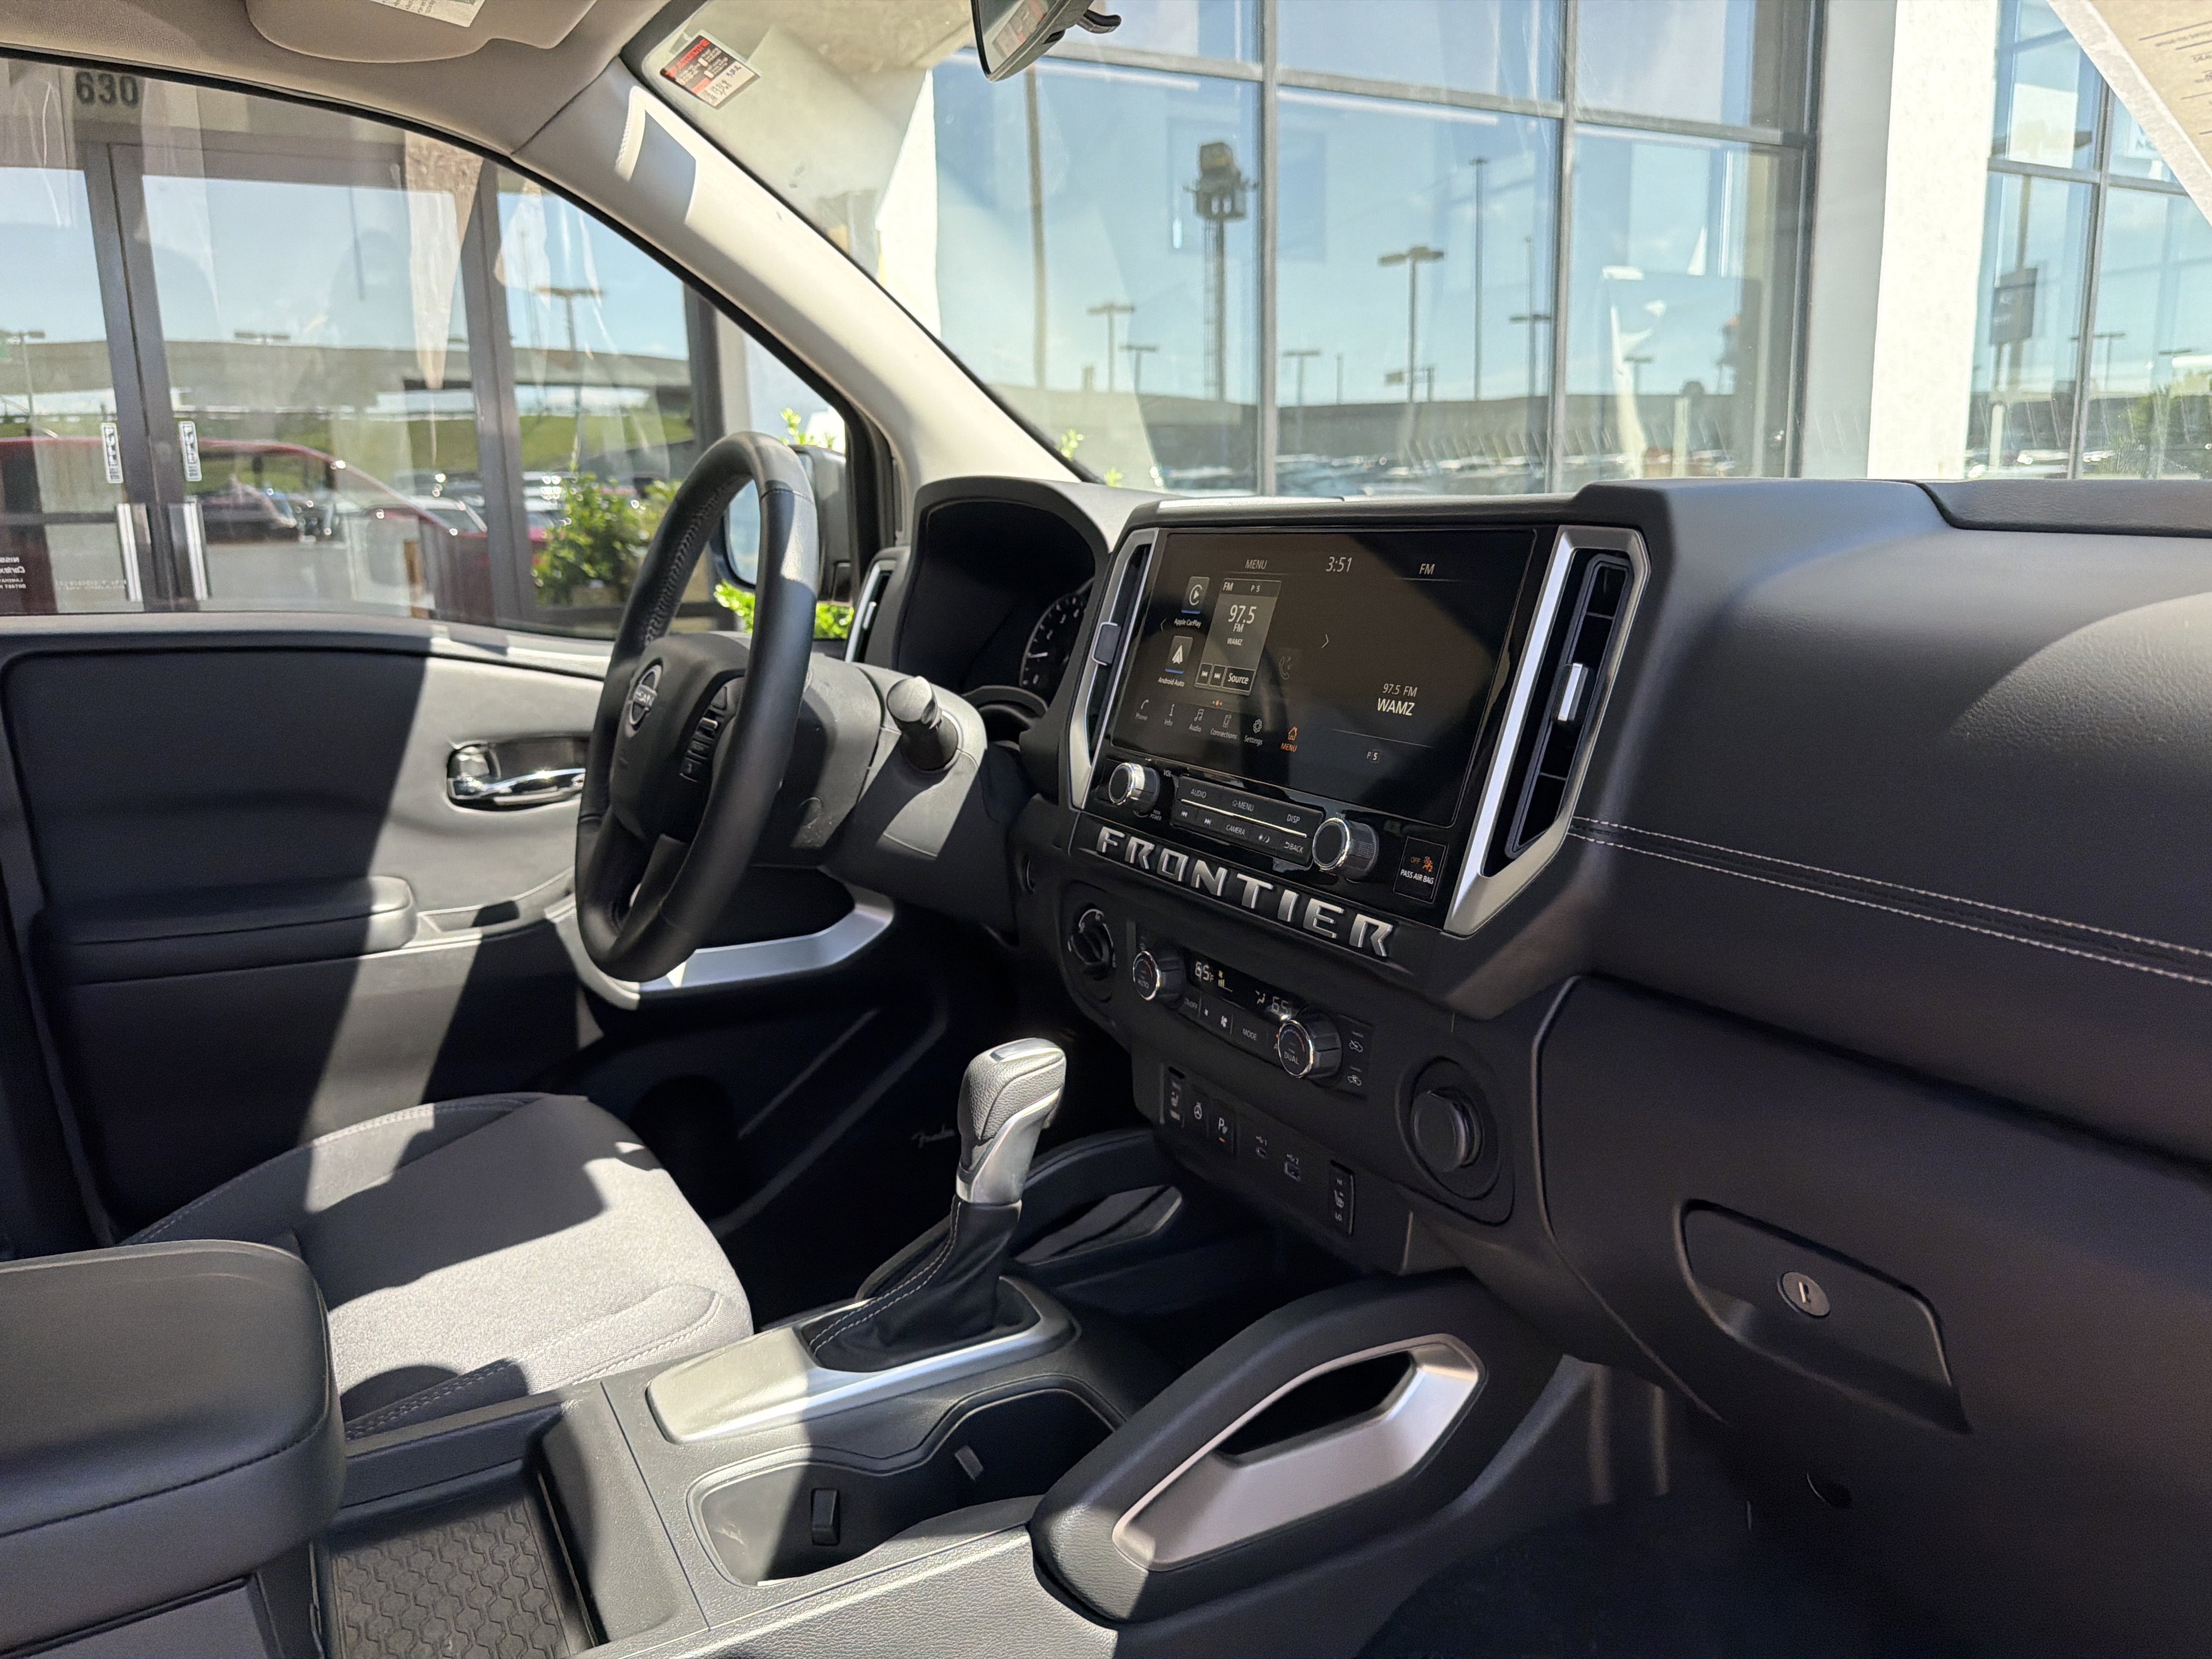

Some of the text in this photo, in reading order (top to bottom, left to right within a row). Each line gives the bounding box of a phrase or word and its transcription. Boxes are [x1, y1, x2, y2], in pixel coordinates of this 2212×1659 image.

[75, 71, 140, 109] 630
[1245, 559, 1268, 569] MENU
[1325, 556, 1352, 573] 3:51
[1419, 563, 1436, 575] FM
[1222, 582, 1234, 592] FM
[1228, 604, 1257, 624] 97.5
[1173, 618, 1201, 628] Apple CarPlay
[1233, 623, 1244, 633] FM
[1227, 637, 1243, 646] WAMZ
[1158, 676, 1185, 687] Android Auto
[1227, 673, 1249, 685] Source
[1383, 683, 1418, 697] 97.5 FM
[1377, 697, 1415, 716] WAMZ
[1188, 724, 1201, 732] Audio
[1210, 728, 1238, 740] Connections
[1244, 735, 1263, 747] Settings
[1280, 742, 1297, 753] MENU
[1373, 752, 1378, 760] 5
[1163, 769, 1172, 777] VOL
[1190, 788, 1207, 799] AUDIO
[1237, 800, 1255, 812] MENU
[1286, 814, 1300, 824] DISP
[1226, 824, 1245, 836] CAMERA
[1289, 843, 1304, 854] BACK
[1410, 856, 1421, 865] OFF
[1400, 869, 1435, 885] PASS AIR BAG
[1097, 825, 1394, 957] FRONTIER
[1137, 979, 1150, 989] AUTO
[1242, 1028, 1257, 1041] MODE
[1284, 1051, 1300, 1065] DUAL
[1218, 1117, 1225, 1131] P
